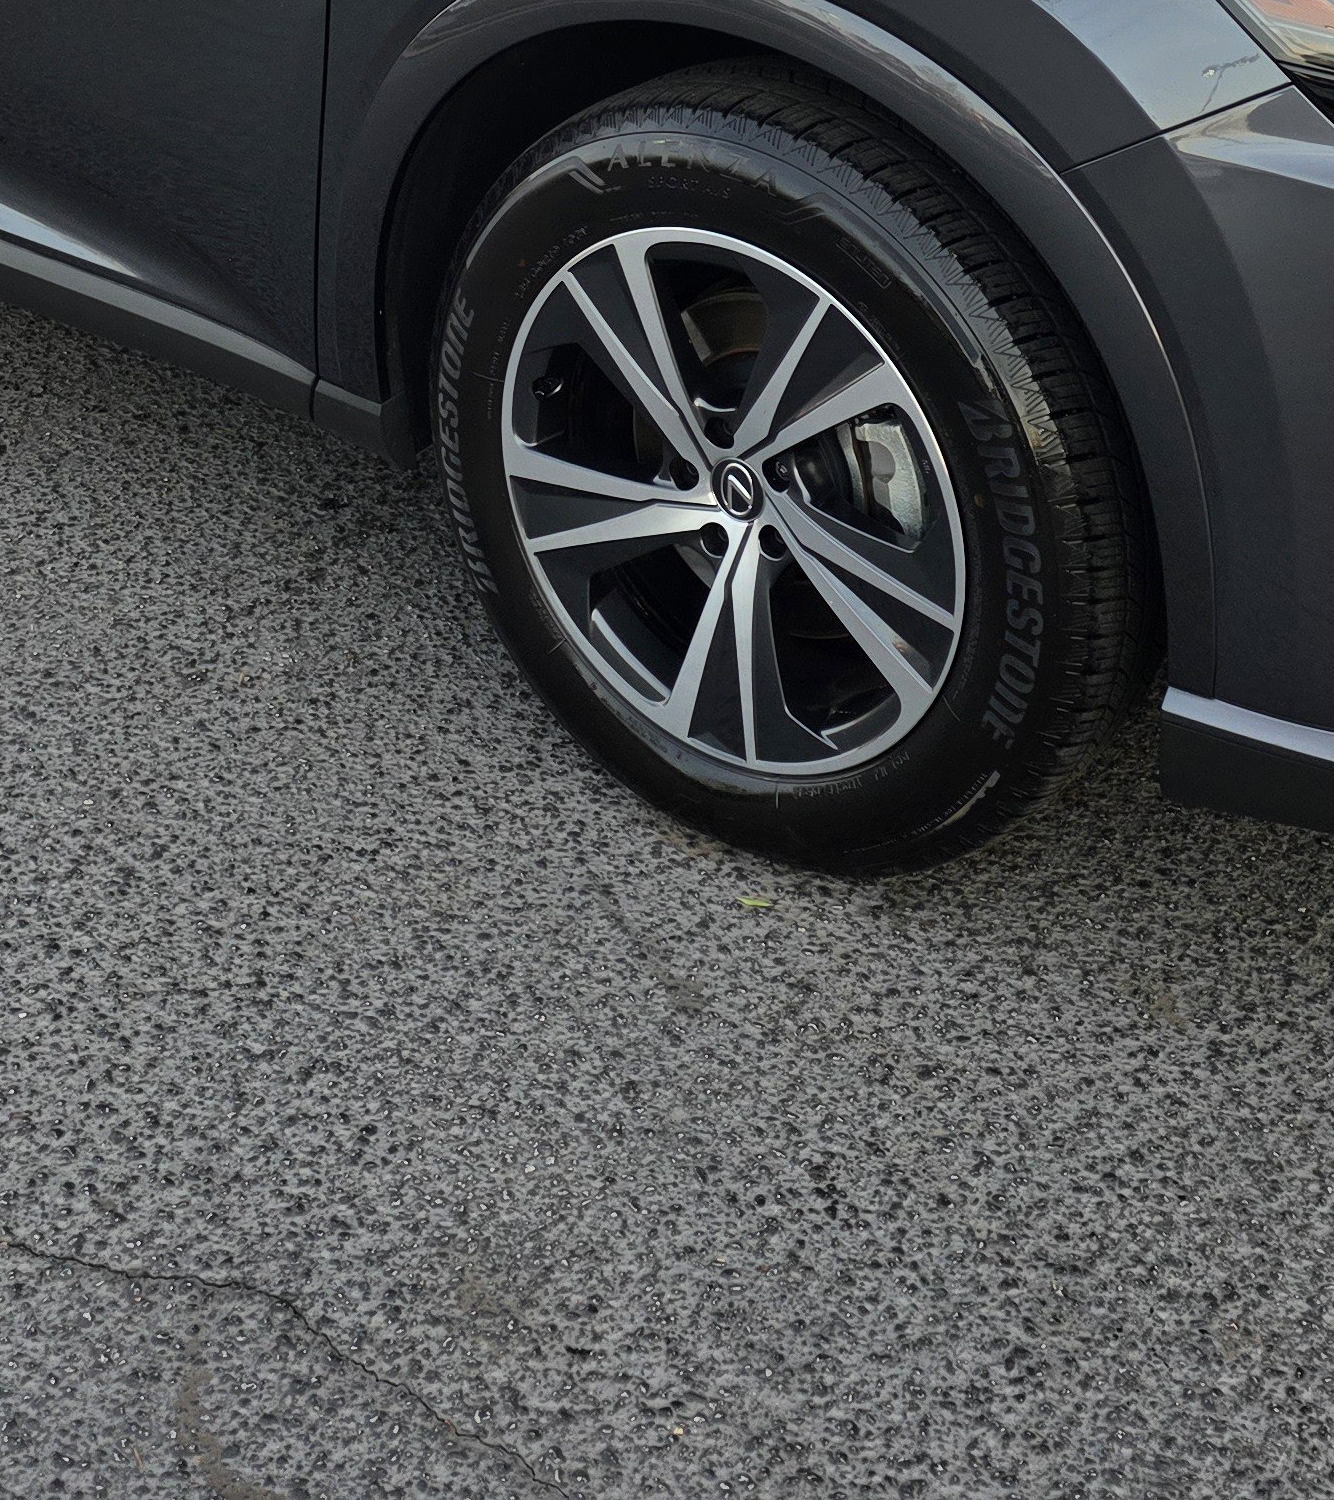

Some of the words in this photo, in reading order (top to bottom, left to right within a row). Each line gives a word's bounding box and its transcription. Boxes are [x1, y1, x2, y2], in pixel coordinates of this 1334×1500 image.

[607, 139, 777, 197] ALENZA
[438, 287, 499, 595] BRIDGESTONE
[957, 400, 1044, 750] BRIDGESTONE
